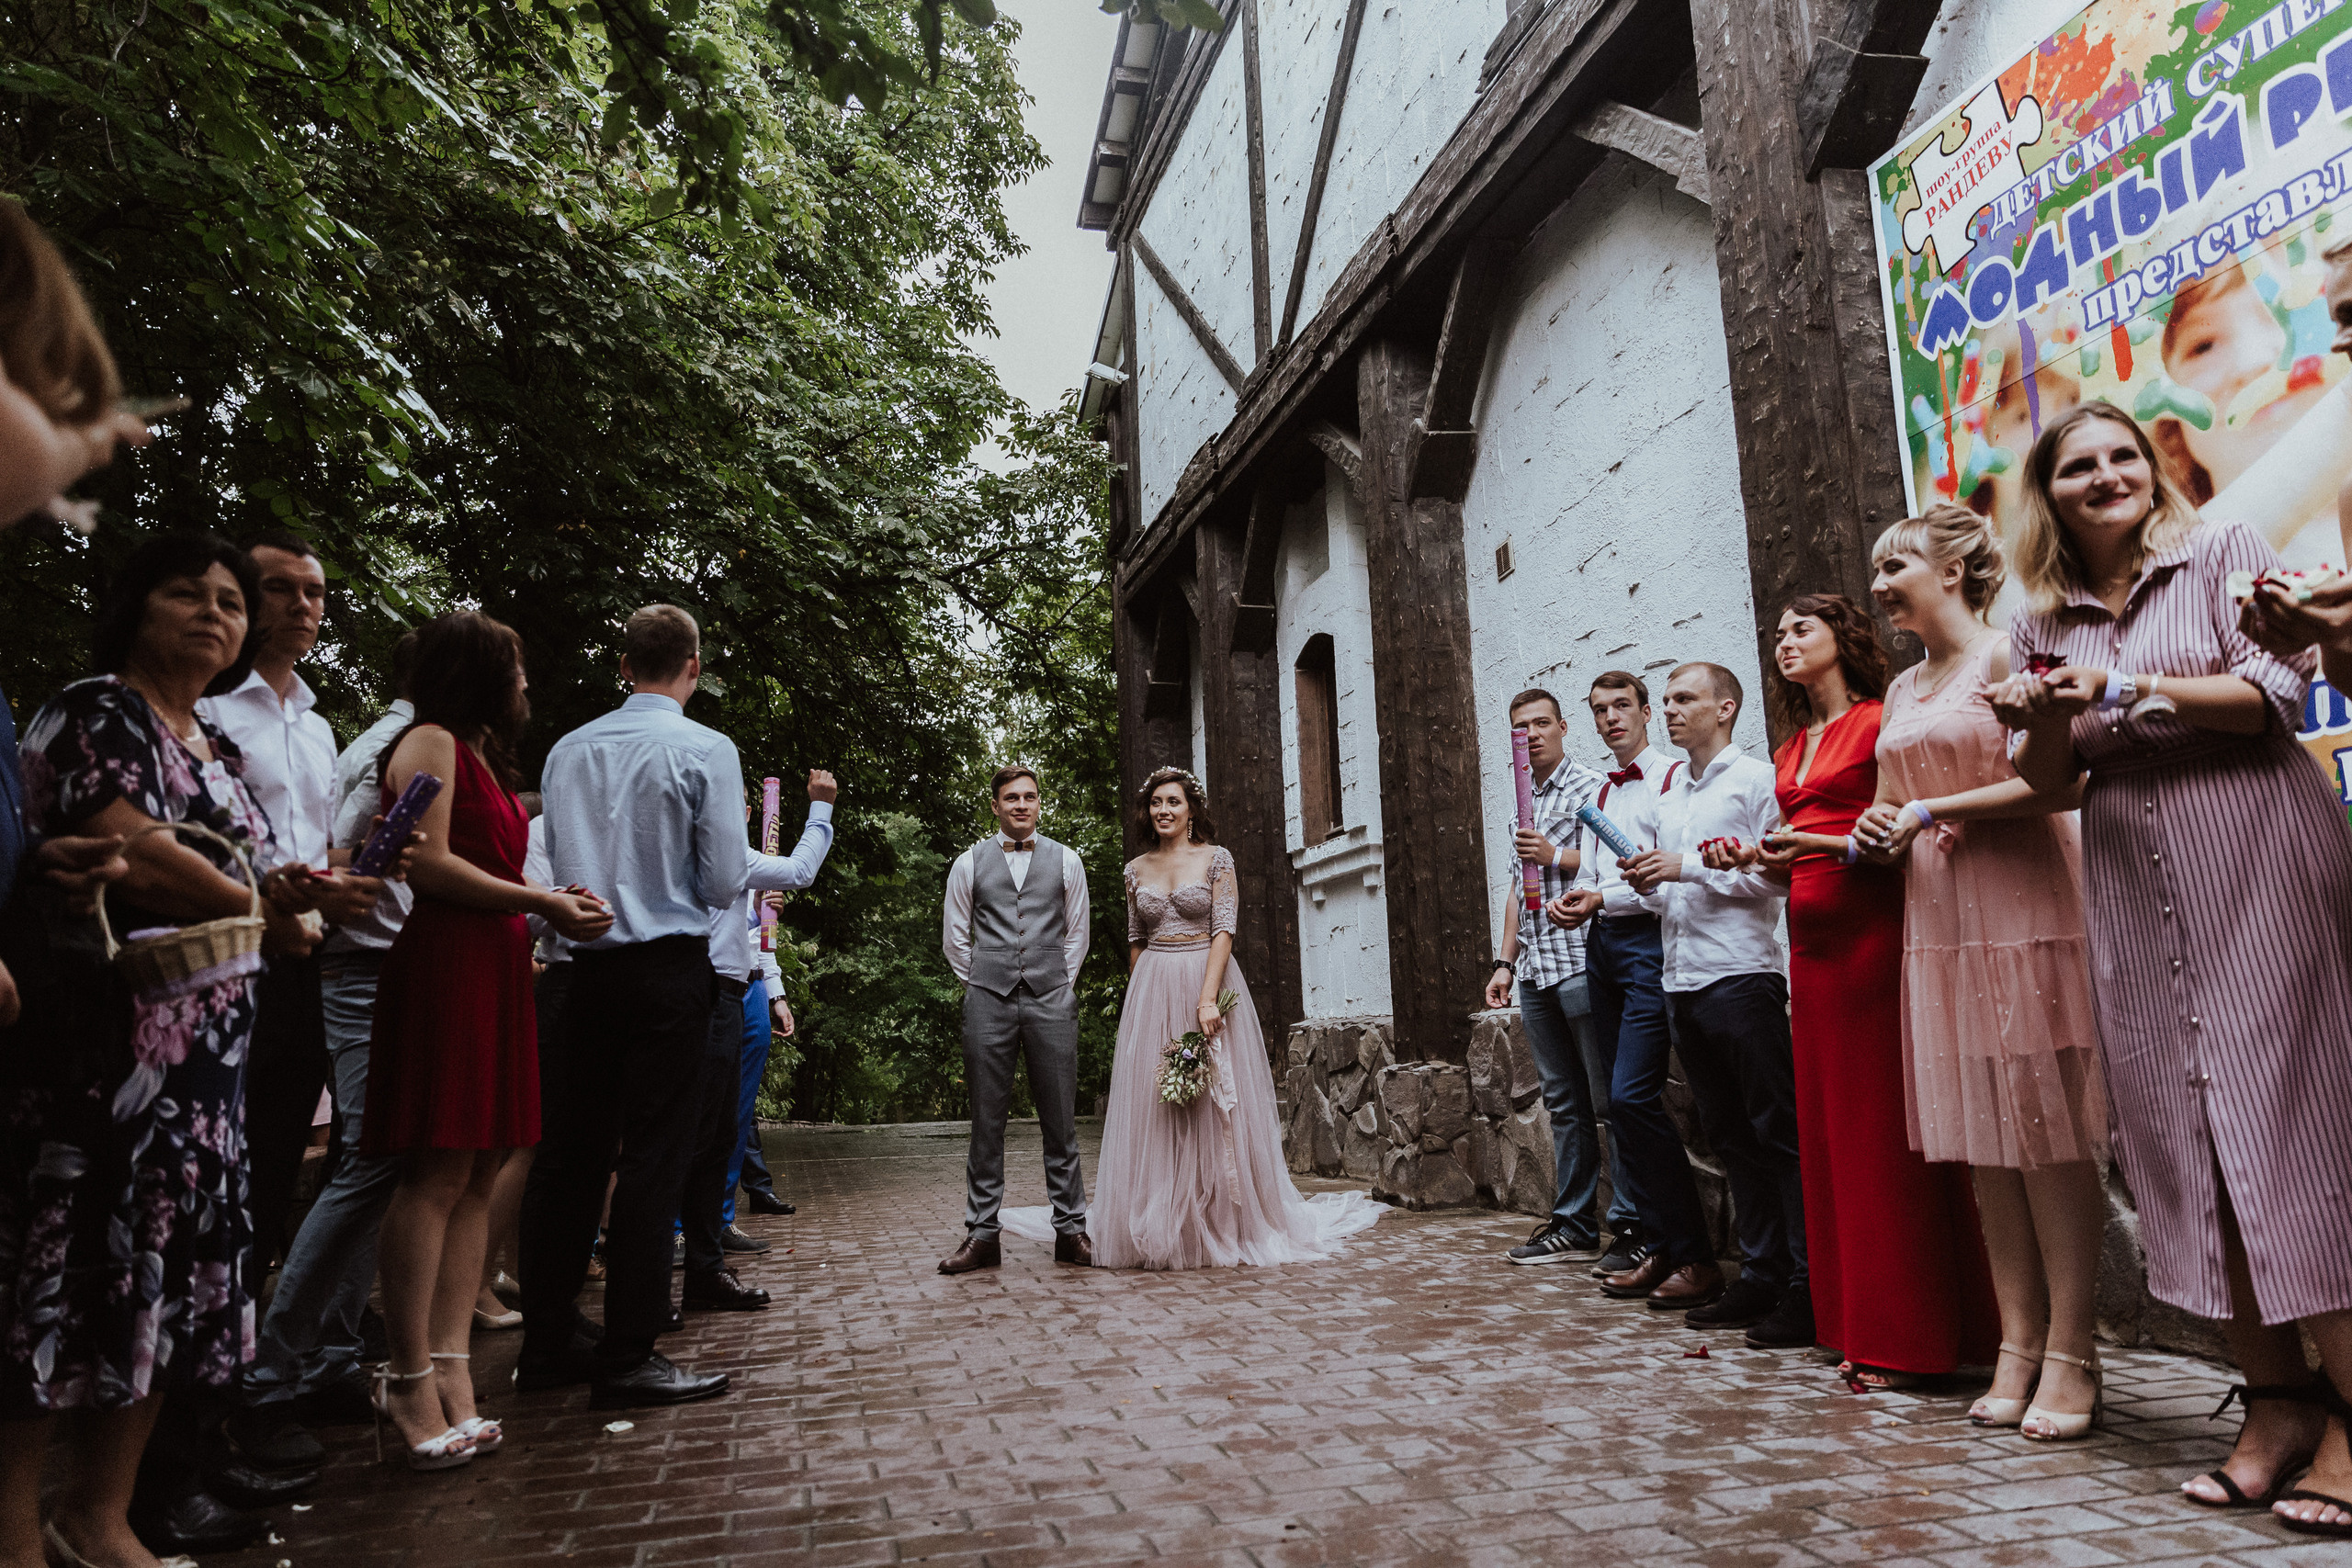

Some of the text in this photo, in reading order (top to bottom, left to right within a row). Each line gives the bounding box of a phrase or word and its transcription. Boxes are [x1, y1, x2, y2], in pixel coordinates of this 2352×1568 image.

[1926, 121, 2001, 198] шоу-группа
[1989, 0, 2344, 240] ДЕТСКИЙ СУПЕ
[1918, 92, 2247, 360] МОДНЫЙ
[1925, 130, 2013, 229] РАНДЕВУ
[1590, 811, 1636, 858] ОПУШКА
